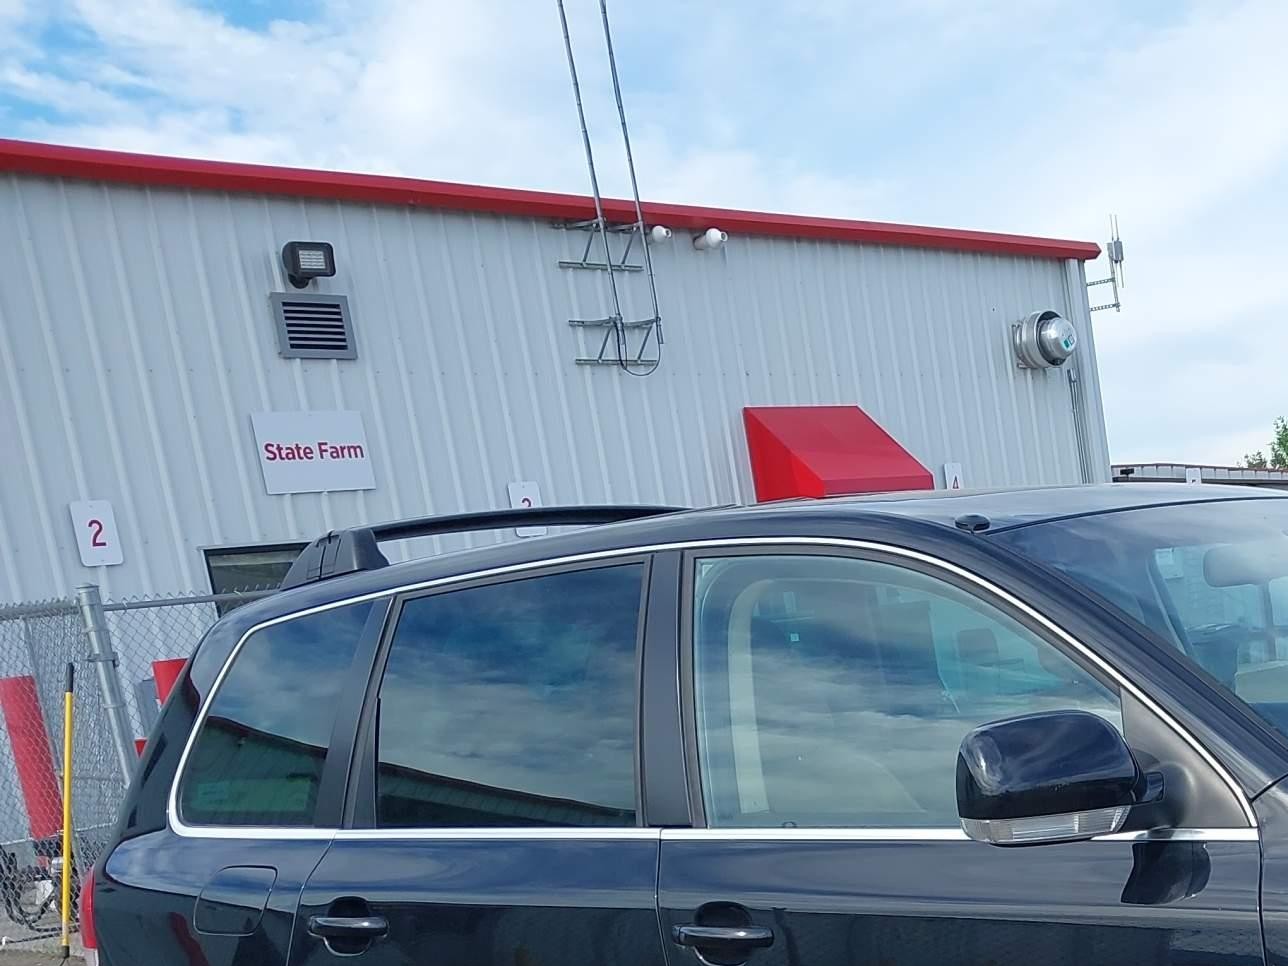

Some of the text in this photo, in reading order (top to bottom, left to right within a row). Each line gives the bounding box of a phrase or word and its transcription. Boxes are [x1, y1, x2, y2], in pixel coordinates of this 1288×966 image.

[264, 441, 365, 461] State Farm
[87, 519, 107, 547] 2
